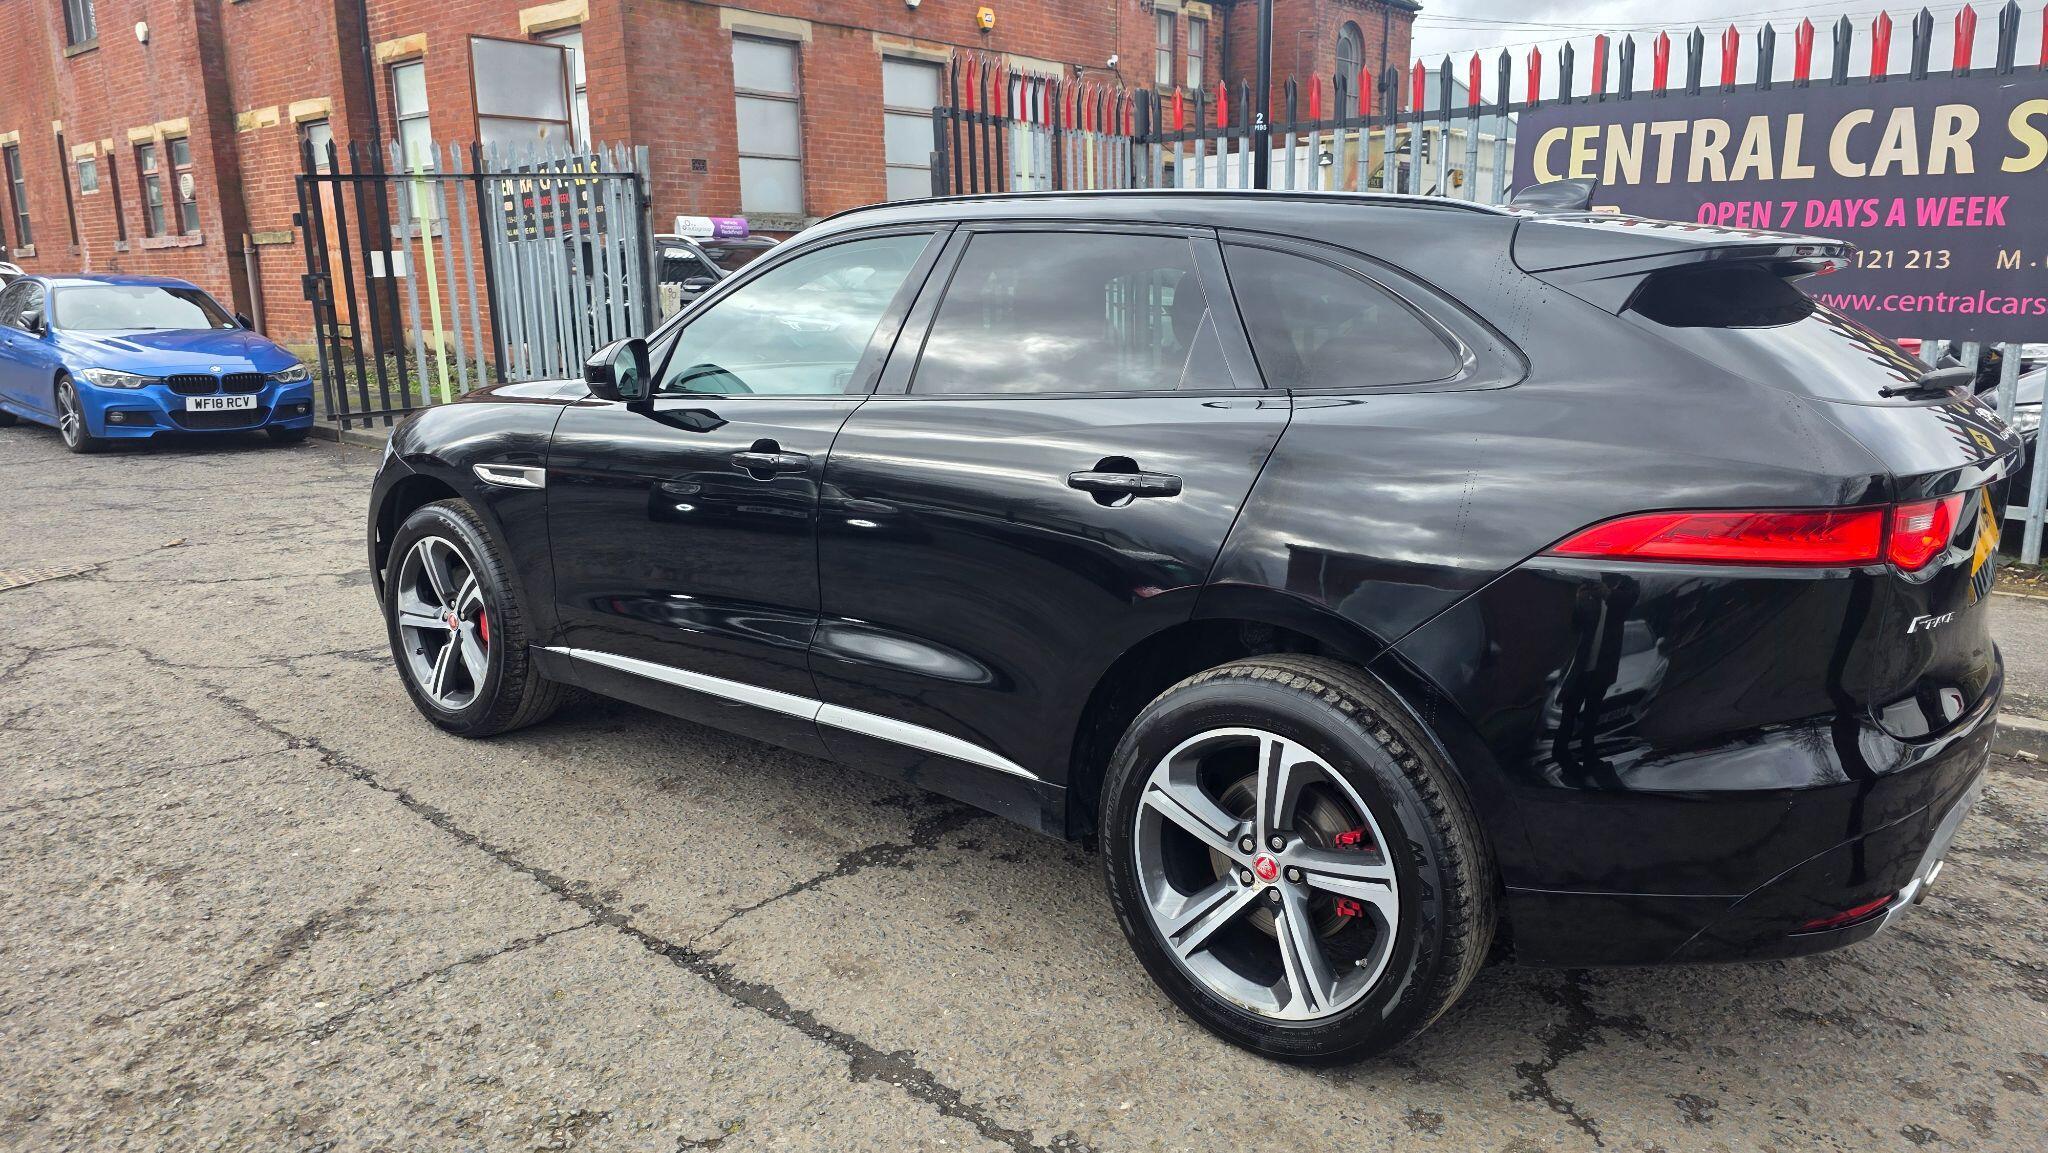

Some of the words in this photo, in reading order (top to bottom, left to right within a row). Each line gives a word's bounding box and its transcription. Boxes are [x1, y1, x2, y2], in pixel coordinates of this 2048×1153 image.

[1256, 112, 1264, 124] 2
[1533, 113, 1816, 186] CENTRAL
[1828, 104, 1980, 178] CAR
[2000, 99, 2048, 173] S
[1697, 200, 1773, 229] OPEN
[1780, 201, 1798, 228] 7
[1804, 199, 1880, 228] DAYS
[1885, 197, 1906, 227] A
[1916, 195, 2010, 227] WEEK
[1855, 249, 1895, 269] 121
[1904, 249, 1951, 269] 213
[194, 398, 223, 409] WF18
[226, 397, 250, 408] RCV
